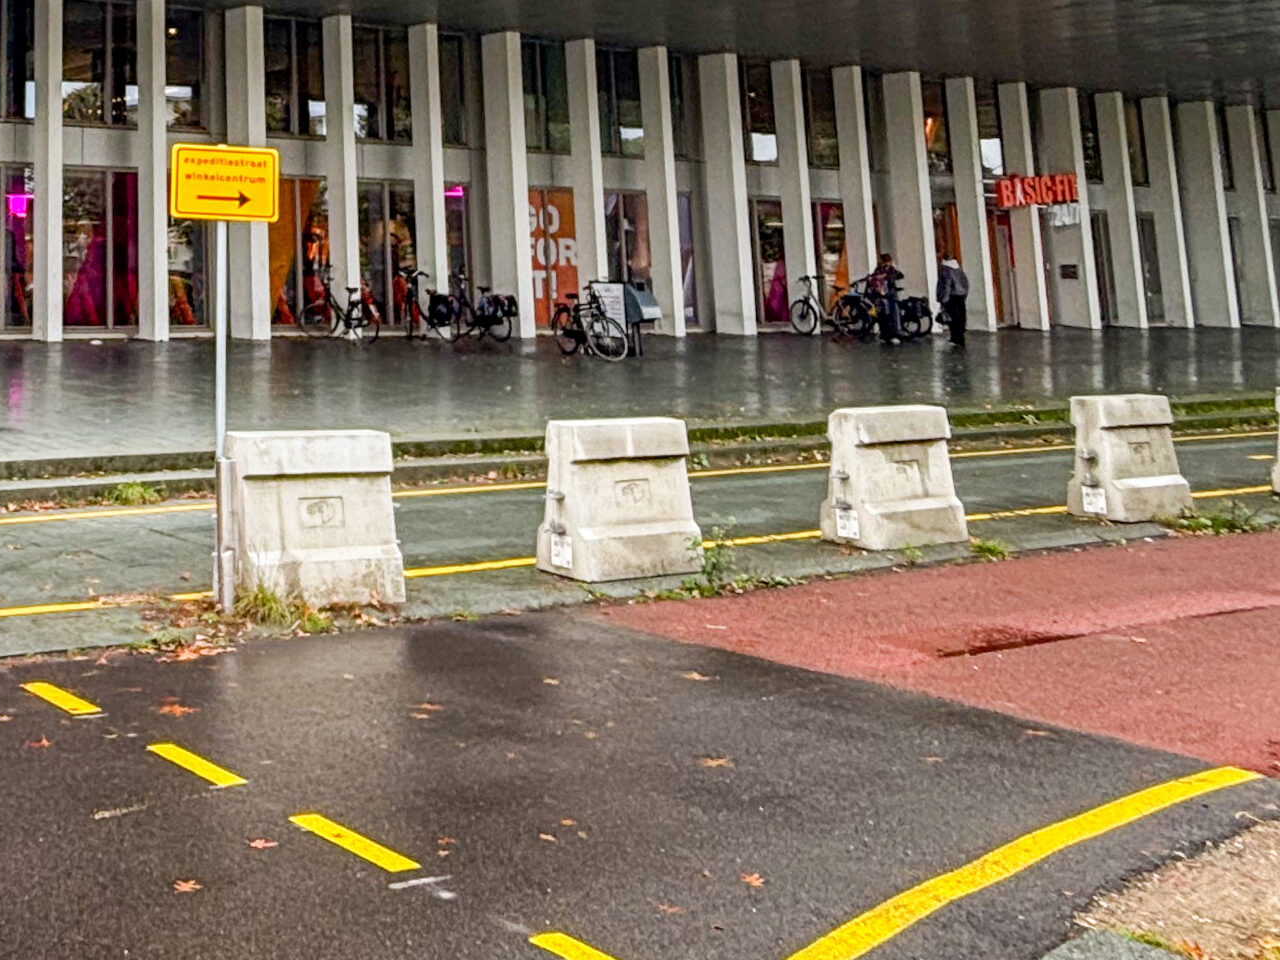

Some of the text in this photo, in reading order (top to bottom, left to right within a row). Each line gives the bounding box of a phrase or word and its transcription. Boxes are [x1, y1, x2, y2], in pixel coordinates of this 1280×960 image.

[184, 157, 266, 168] expeditiestraat
[185, 172, 266, 183] winkelcentrum
[999, 173, 1079, 208] BASIC-FIT
